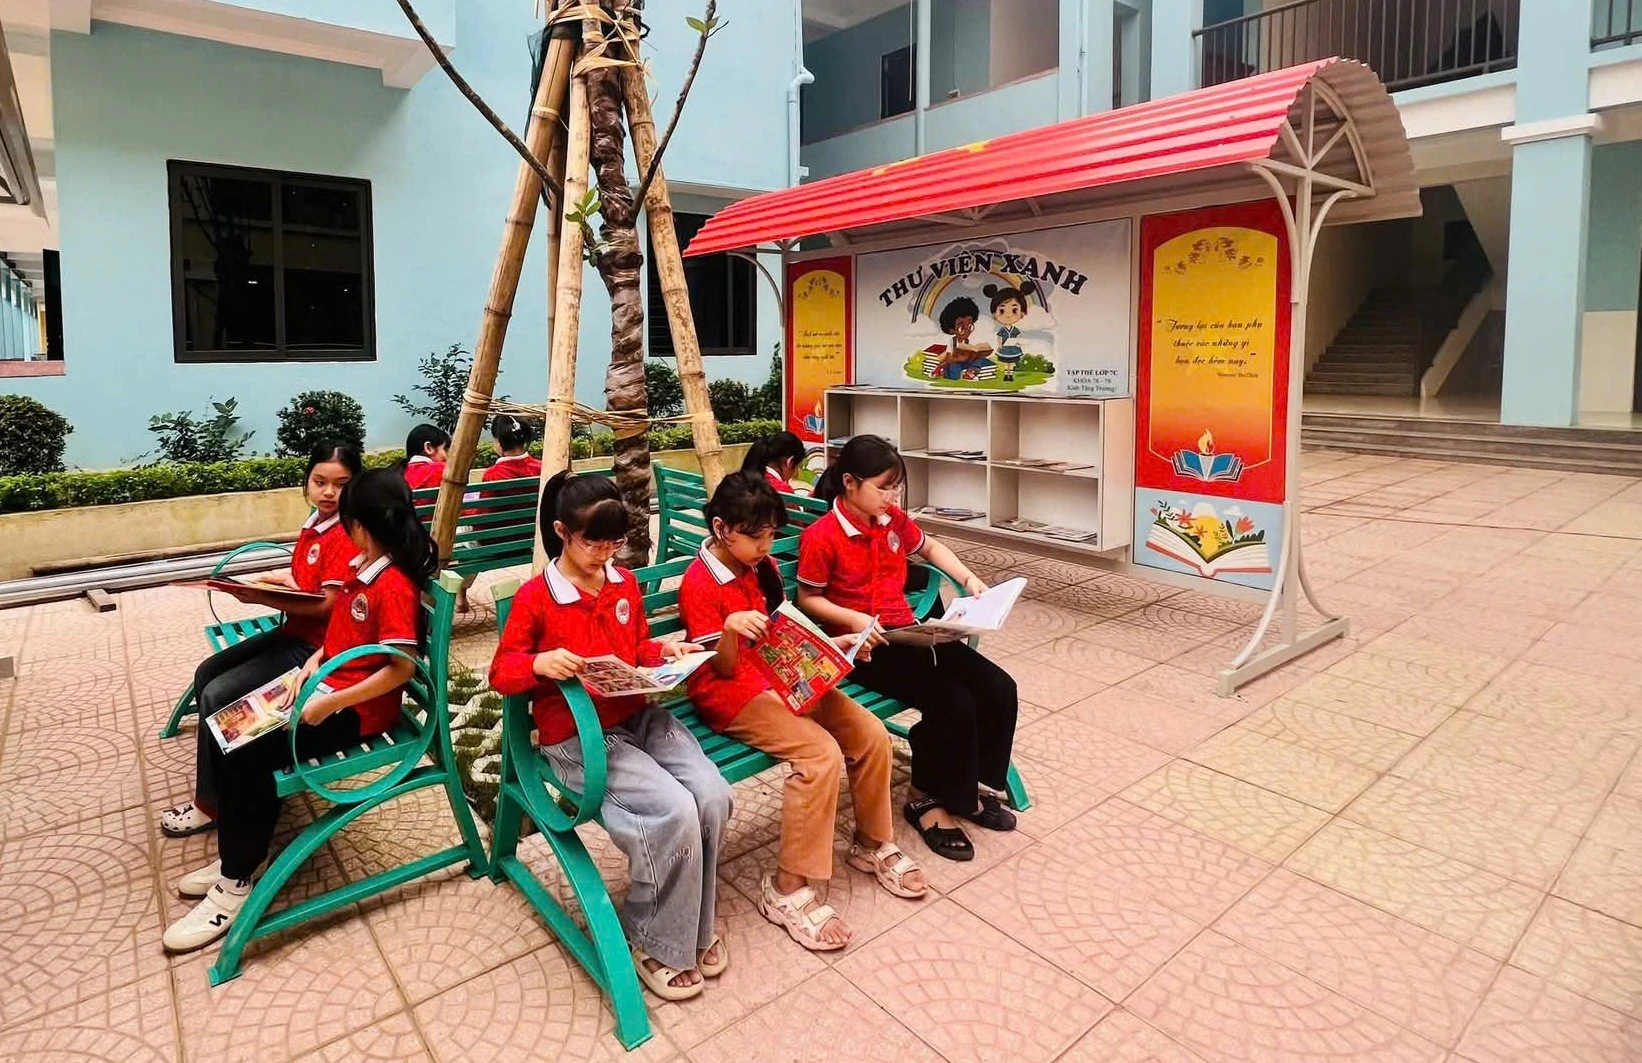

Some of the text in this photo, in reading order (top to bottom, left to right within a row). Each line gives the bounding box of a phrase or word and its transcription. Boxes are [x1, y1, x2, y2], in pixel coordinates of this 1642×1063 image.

[879, 251, 1088, 307] THƯ VIỆN XANH
